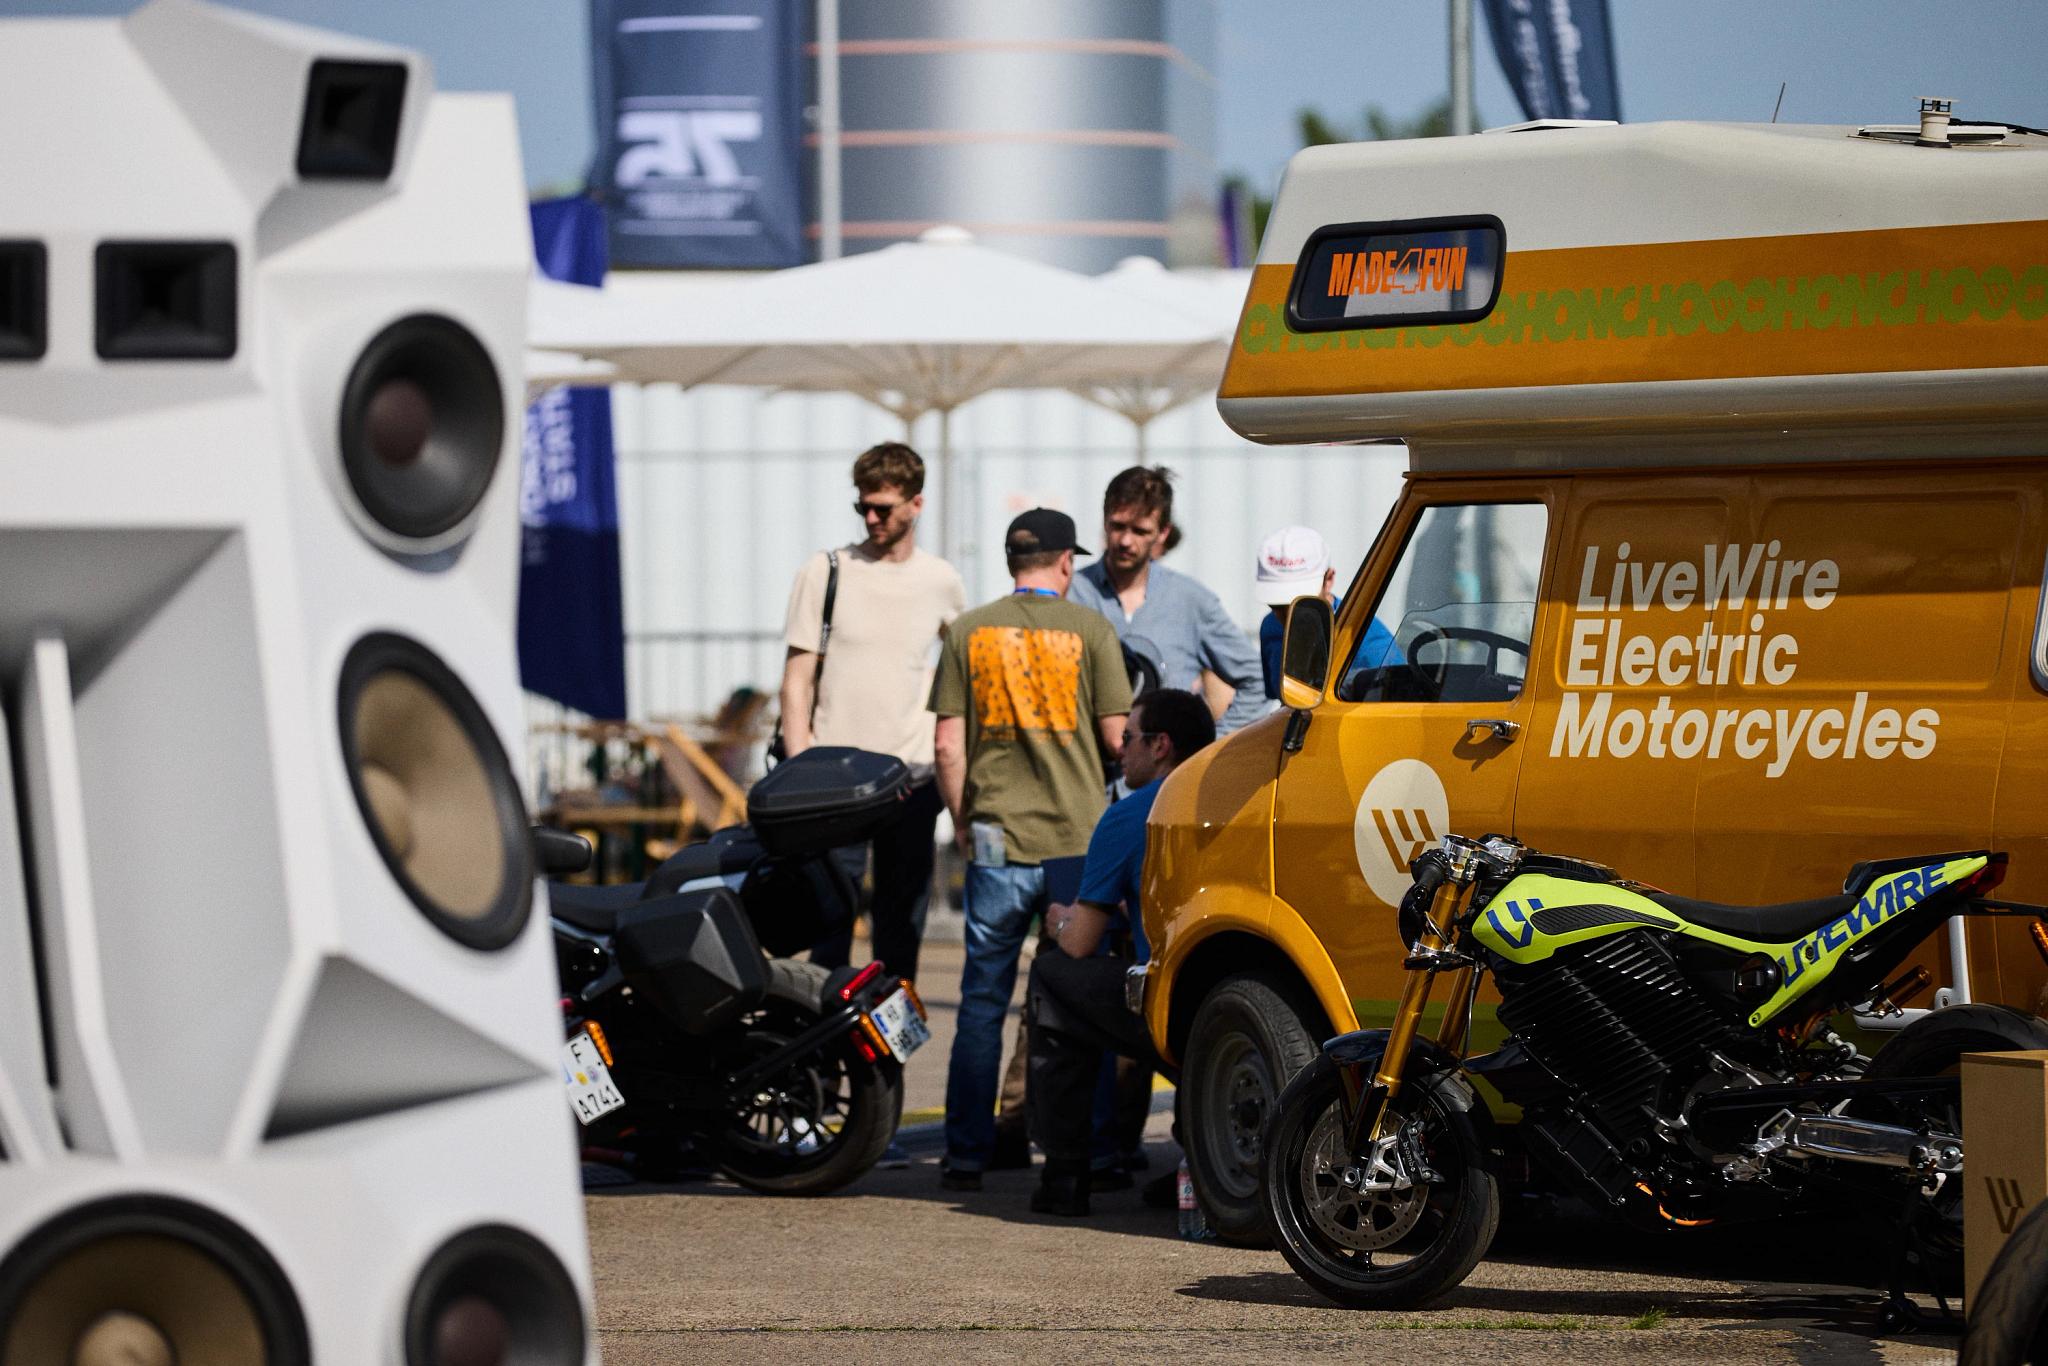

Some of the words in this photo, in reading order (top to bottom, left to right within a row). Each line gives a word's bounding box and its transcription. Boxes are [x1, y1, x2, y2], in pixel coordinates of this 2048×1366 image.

[1576, 540, 1840, 612] LiveWire
[1566, 613, 1798, 686] Electric
[1549, 691, 1940, 778] Motorcycles
